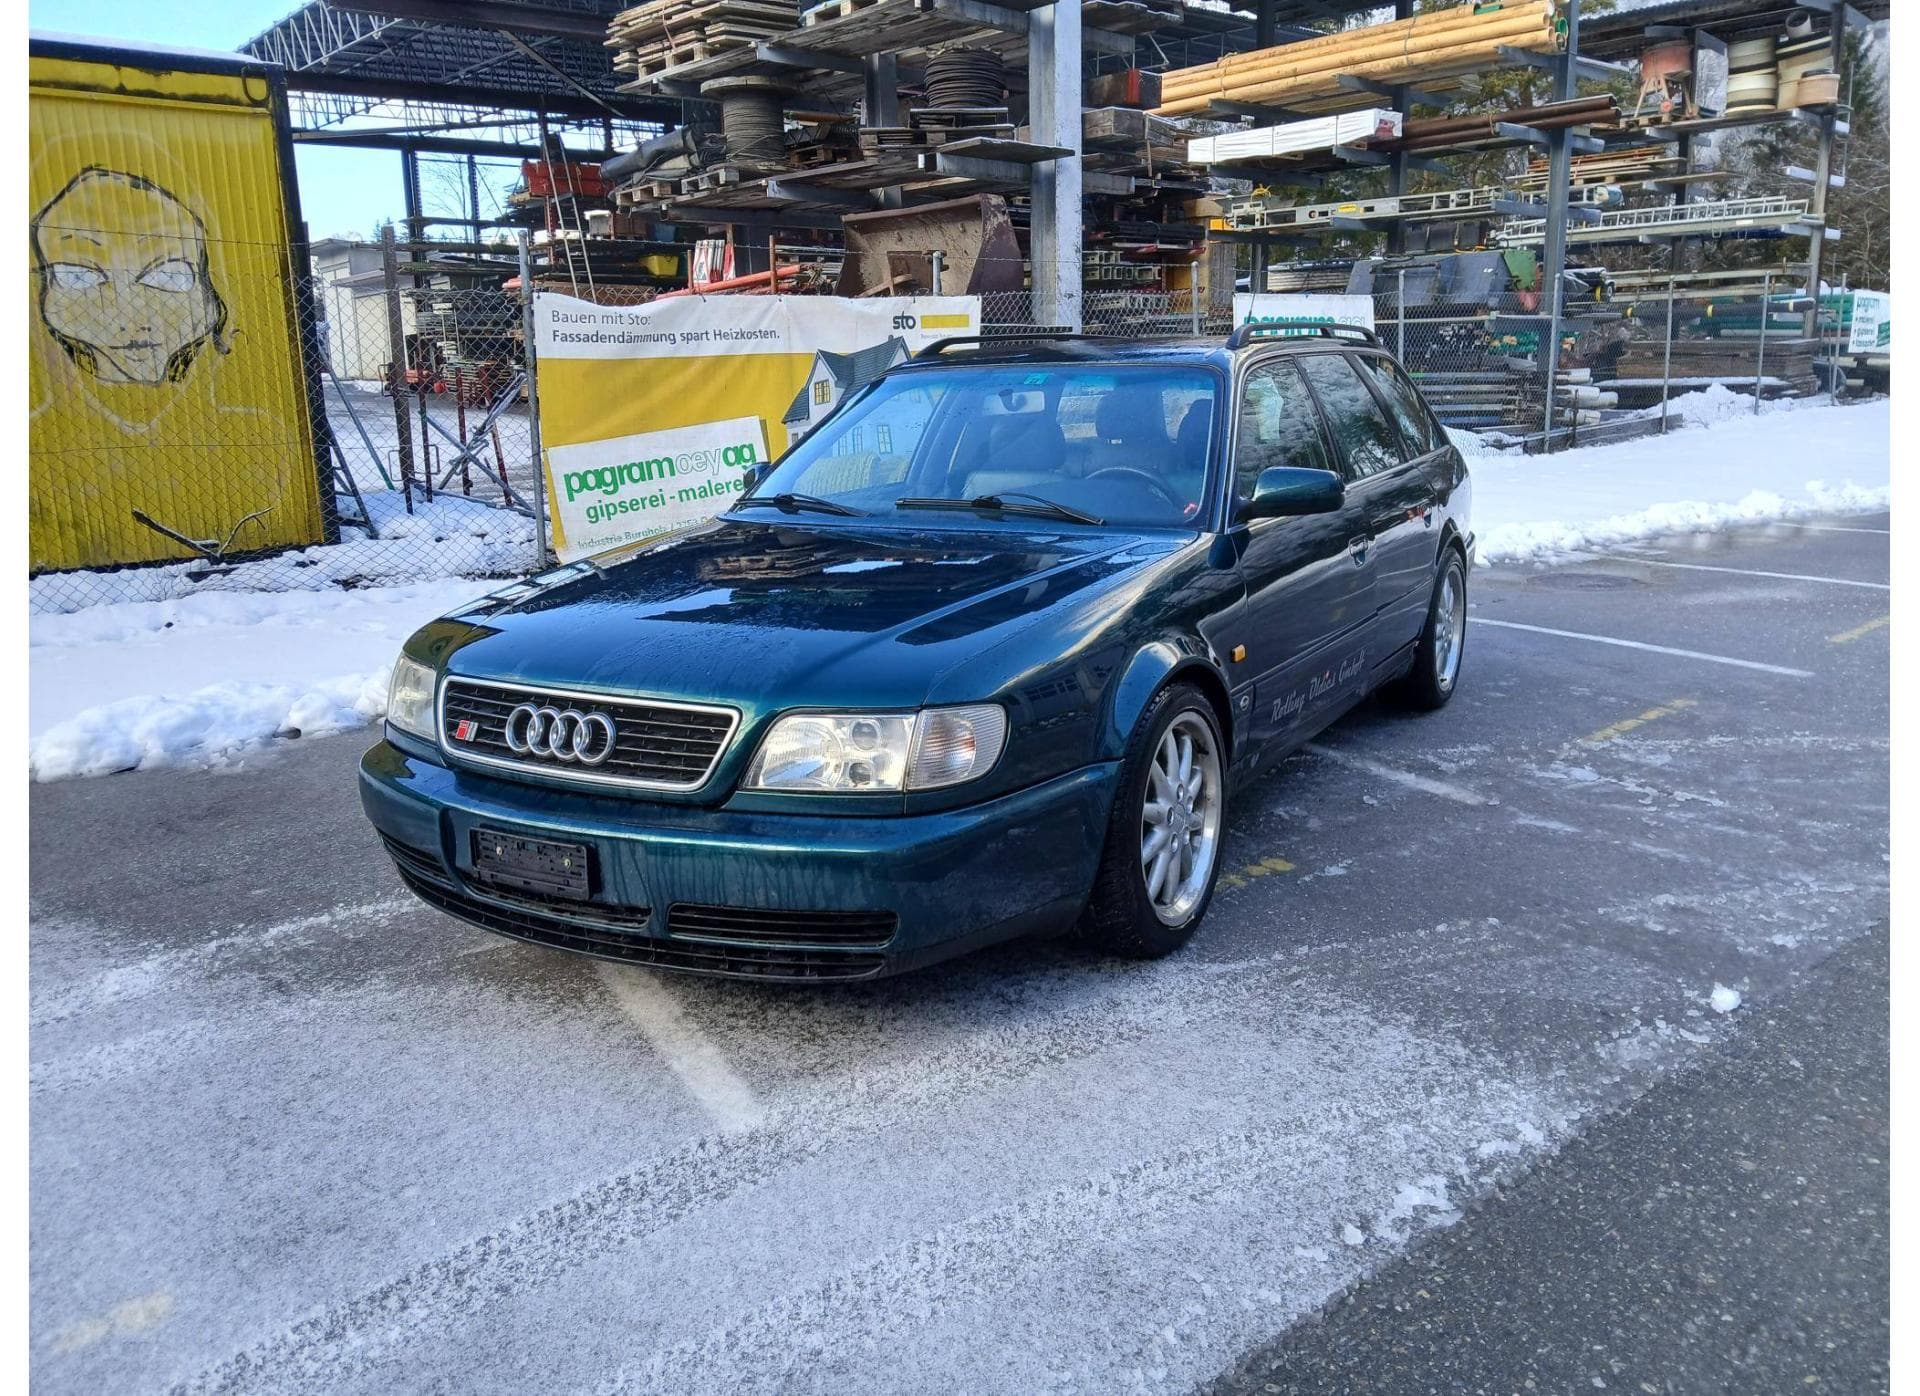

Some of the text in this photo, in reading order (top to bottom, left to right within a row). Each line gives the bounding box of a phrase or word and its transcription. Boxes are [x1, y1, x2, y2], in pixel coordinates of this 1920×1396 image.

[551, 310, 651, 326] Bauen mit Sto:
[892, 311, 916, 330] sto
[552, 328, 780, 344] Fassadendämmung spart Heizkosten.
[586, 489, 666, 524] gipserei
[678, 477, 746, 503] malere
